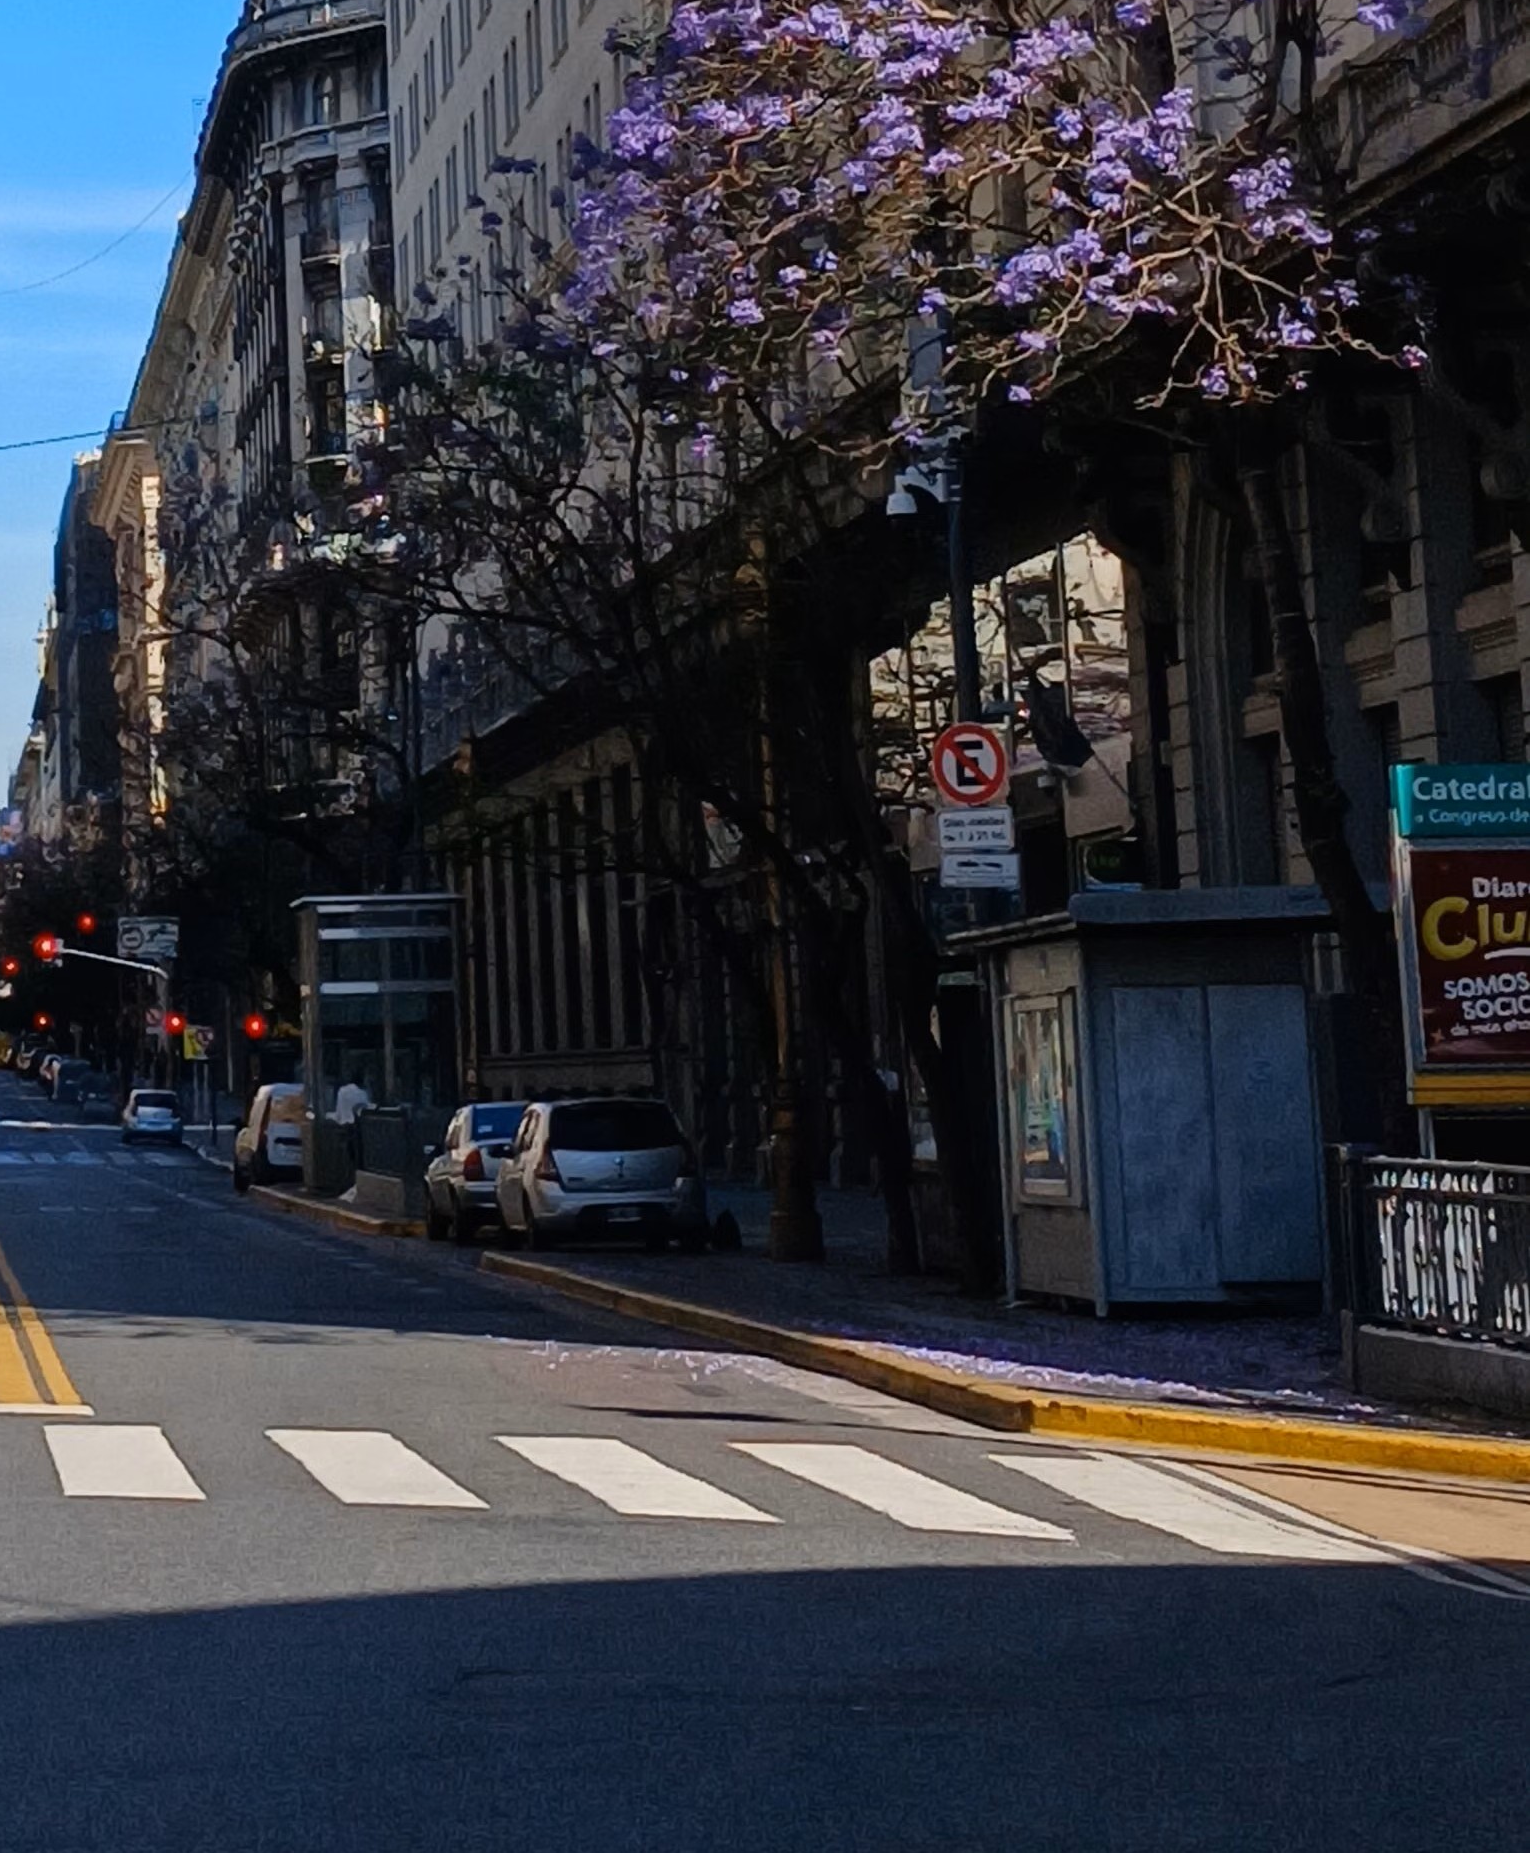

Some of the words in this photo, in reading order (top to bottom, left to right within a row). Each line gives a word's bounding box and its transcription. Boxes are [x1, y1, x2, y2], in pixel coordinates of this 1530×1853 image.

[1412, 774, 1530, 801] Catedral
[1472, 876, 1530, 899] Diar
[1422, 896, 1530, 961] Clu
[1444, 971, 1530, 999] SOMOS
